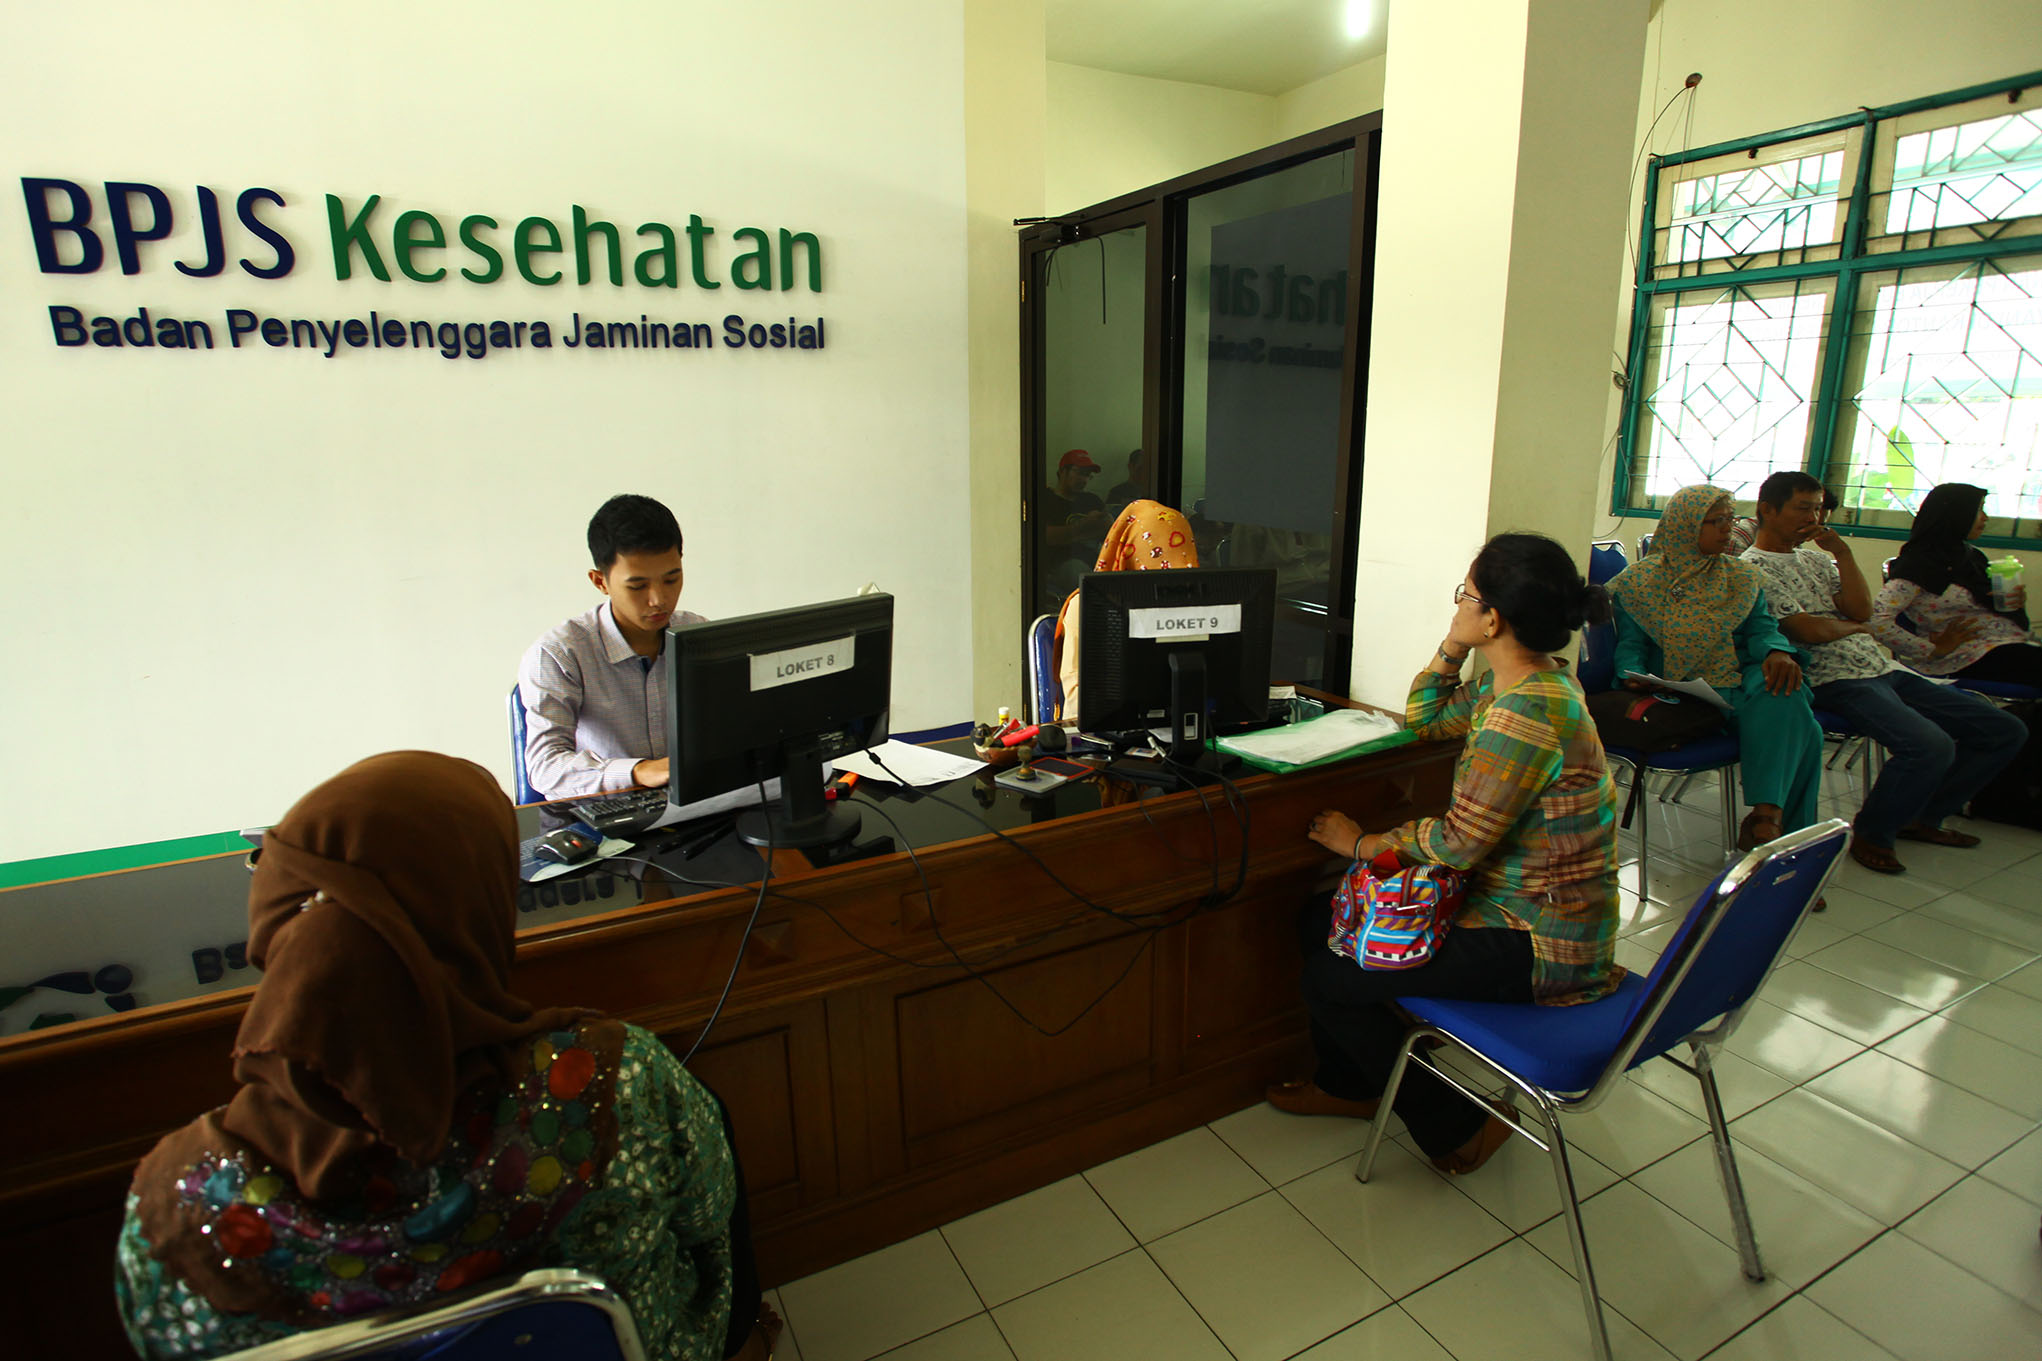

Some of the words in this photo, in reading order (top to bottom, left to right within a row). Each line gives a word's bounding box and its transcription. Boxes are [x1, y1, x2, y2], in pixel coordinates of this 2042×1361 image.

[20, 178, 296, 280] BPJS
[325, 194, 824, 294] Kesehatan
[48, 306, 214, 350] Badan
[225, 309, 553, 360] Penyelenggara
[562, 312, 713, 349] Jaminan
[722, 315, 825, 349] Sosial
[1156, 618, 1206, 631] LOKET
[1210, 617, 1219, 629] 9
[776, 656, 823, 679] LOKET
[827, 654, 835, 666] 8
